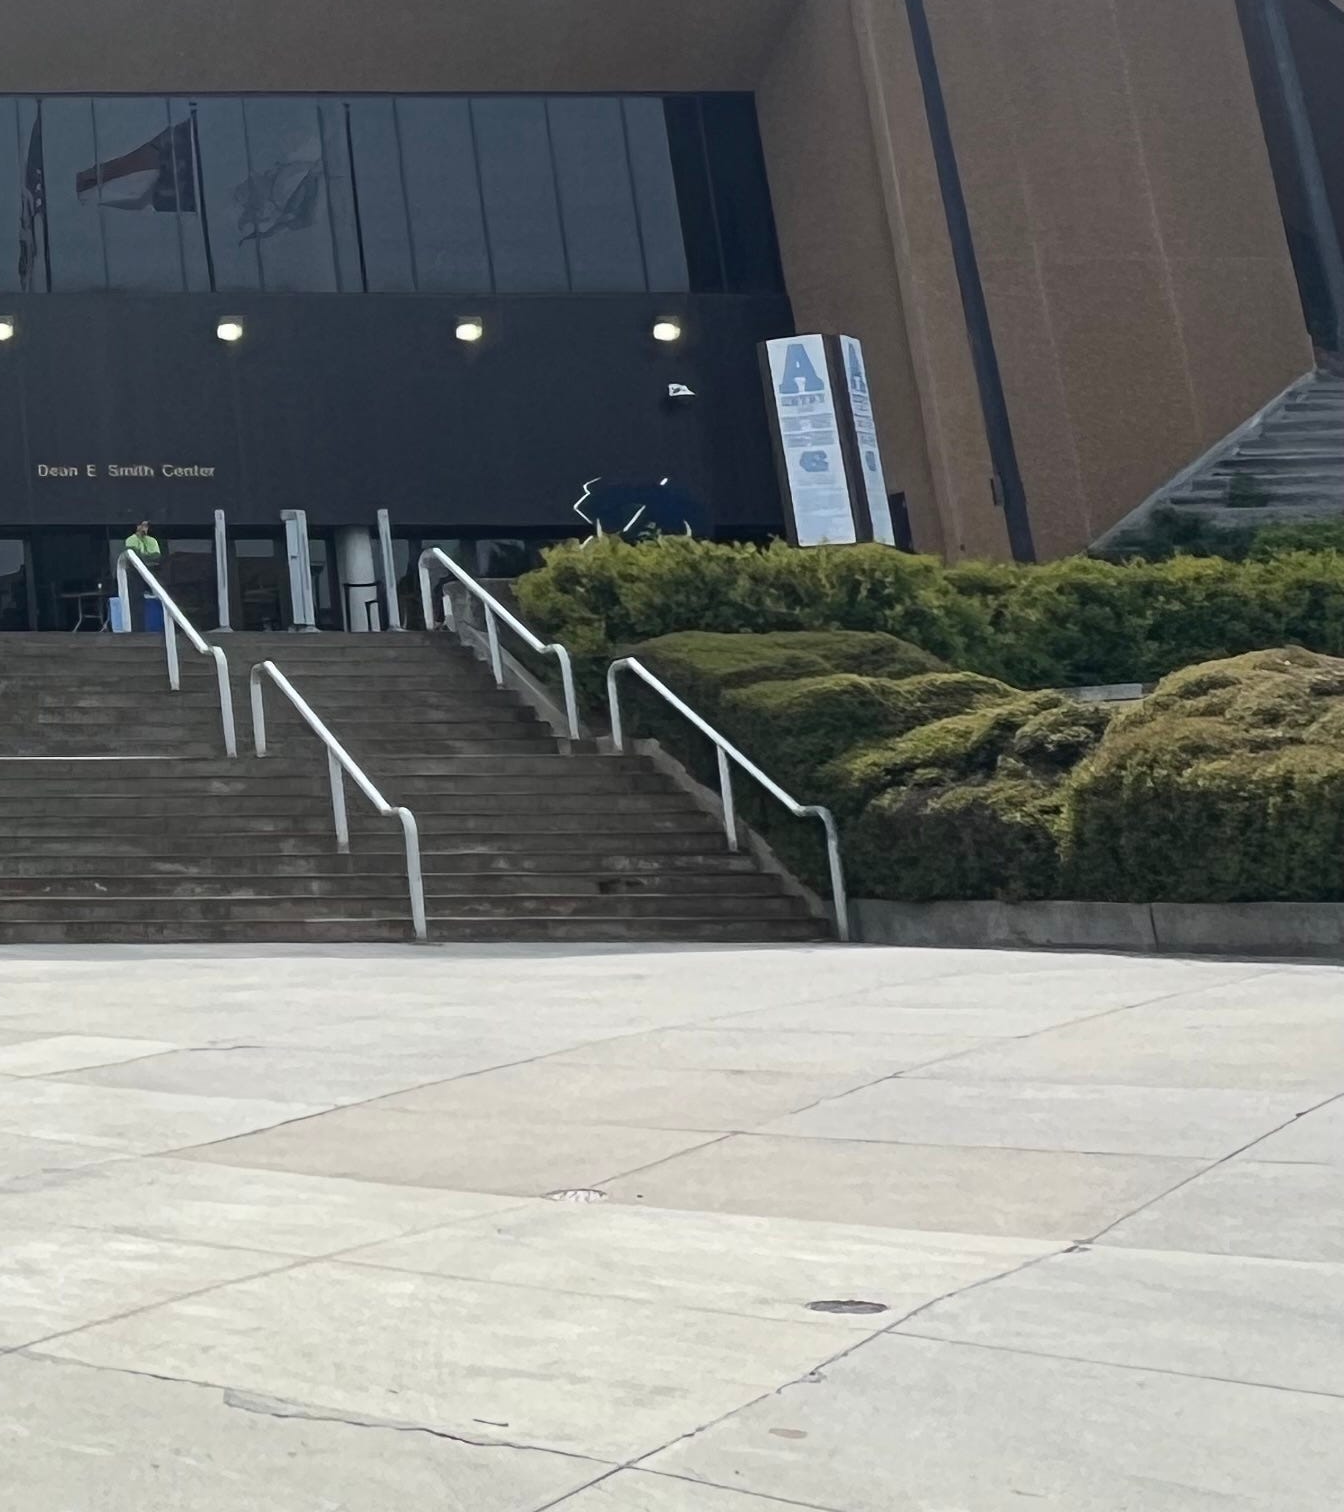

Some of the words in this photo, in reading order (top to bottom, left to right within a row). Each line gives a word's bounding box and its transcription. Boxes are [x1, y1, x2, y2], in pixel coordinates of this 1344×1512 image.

[779, 343, 825, 394] A
[37, 464, 79, 477] Dean
[108, 464, 155, 477] Smith
[162, 464, 216, 477] Center
